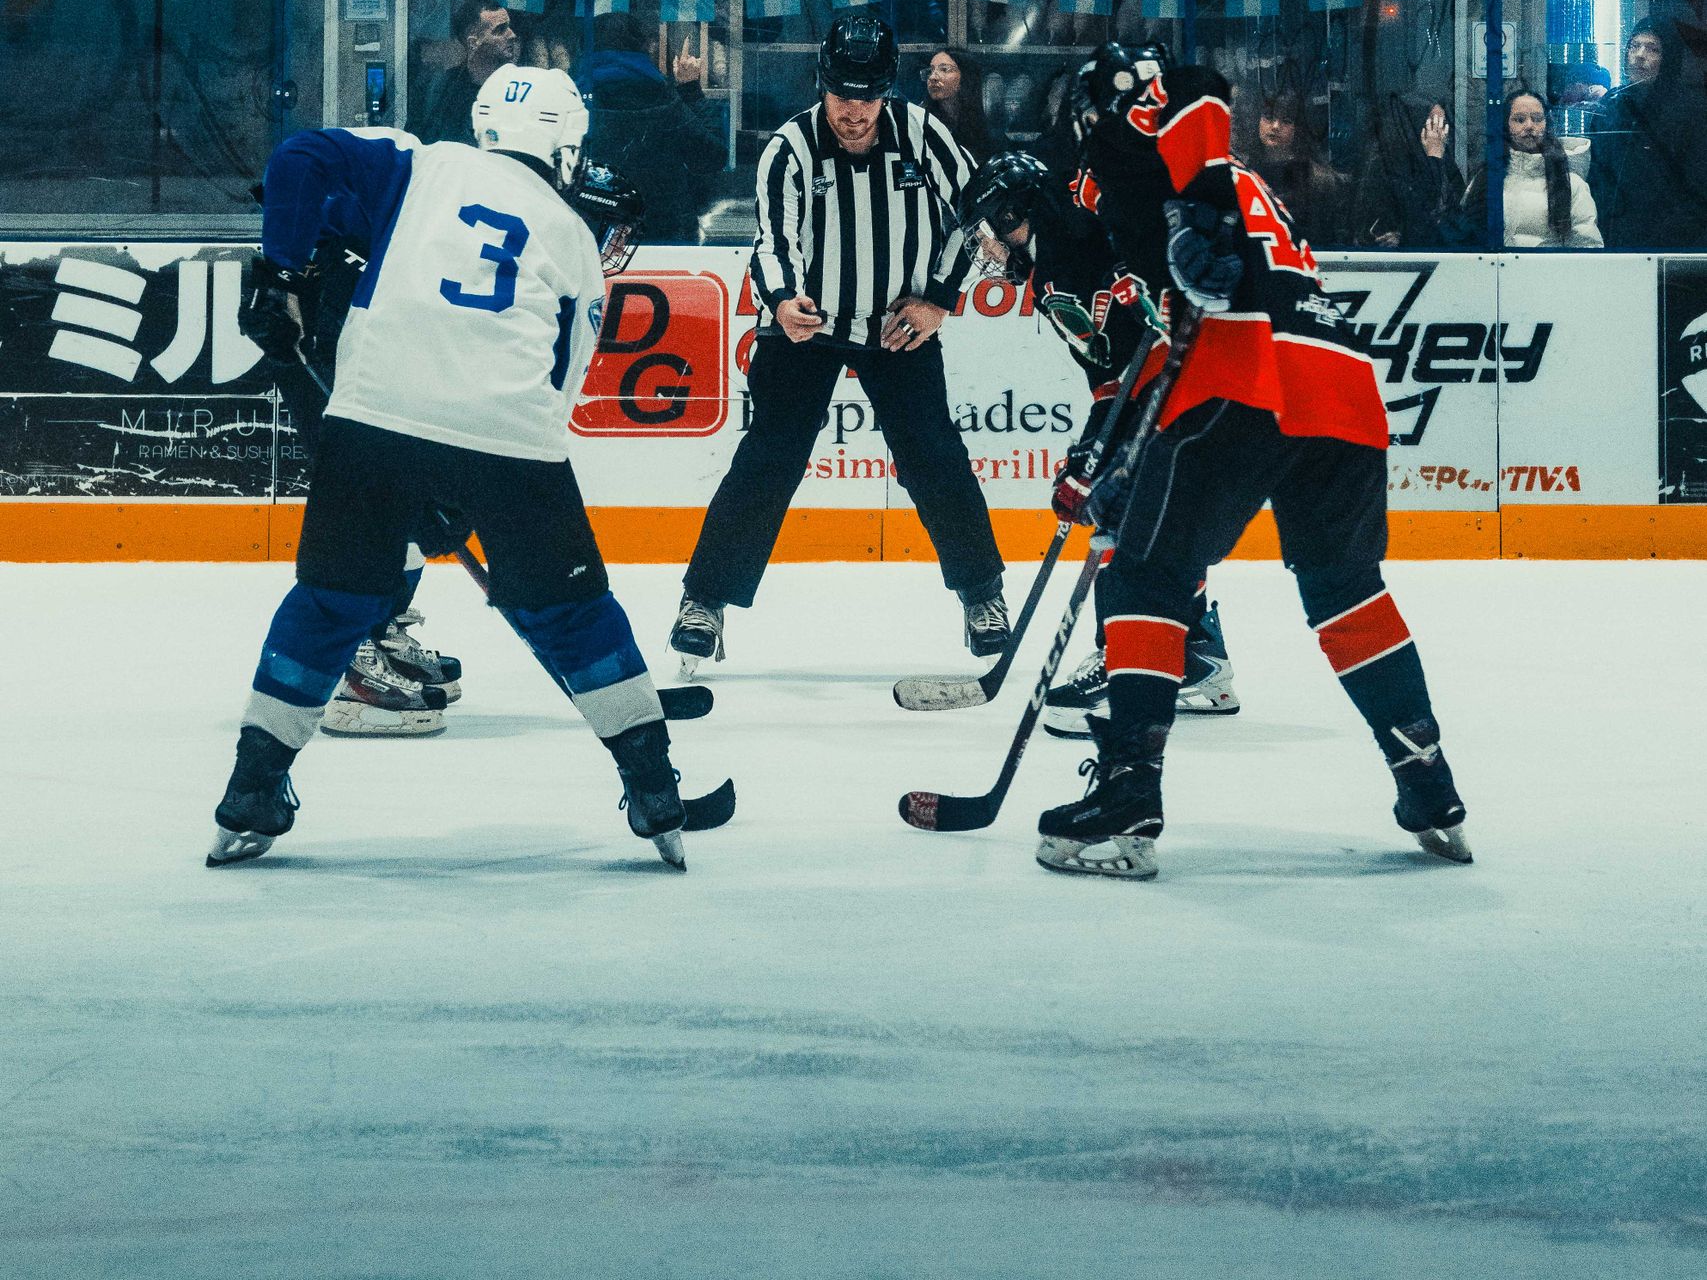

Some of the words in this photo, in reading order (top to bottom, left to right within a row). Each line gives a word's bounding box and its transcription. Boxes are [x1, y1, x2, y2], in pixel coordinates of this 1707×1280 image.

[504, 80, 533, 103] 07
[579, 192, 618, 208] MISSION
[439, 203, 530, 314] 3
[139, 445, 204, 459] RAMEN
[227, 445, 273, 459] SUSHI
[280, 445, 308, 459] RE
